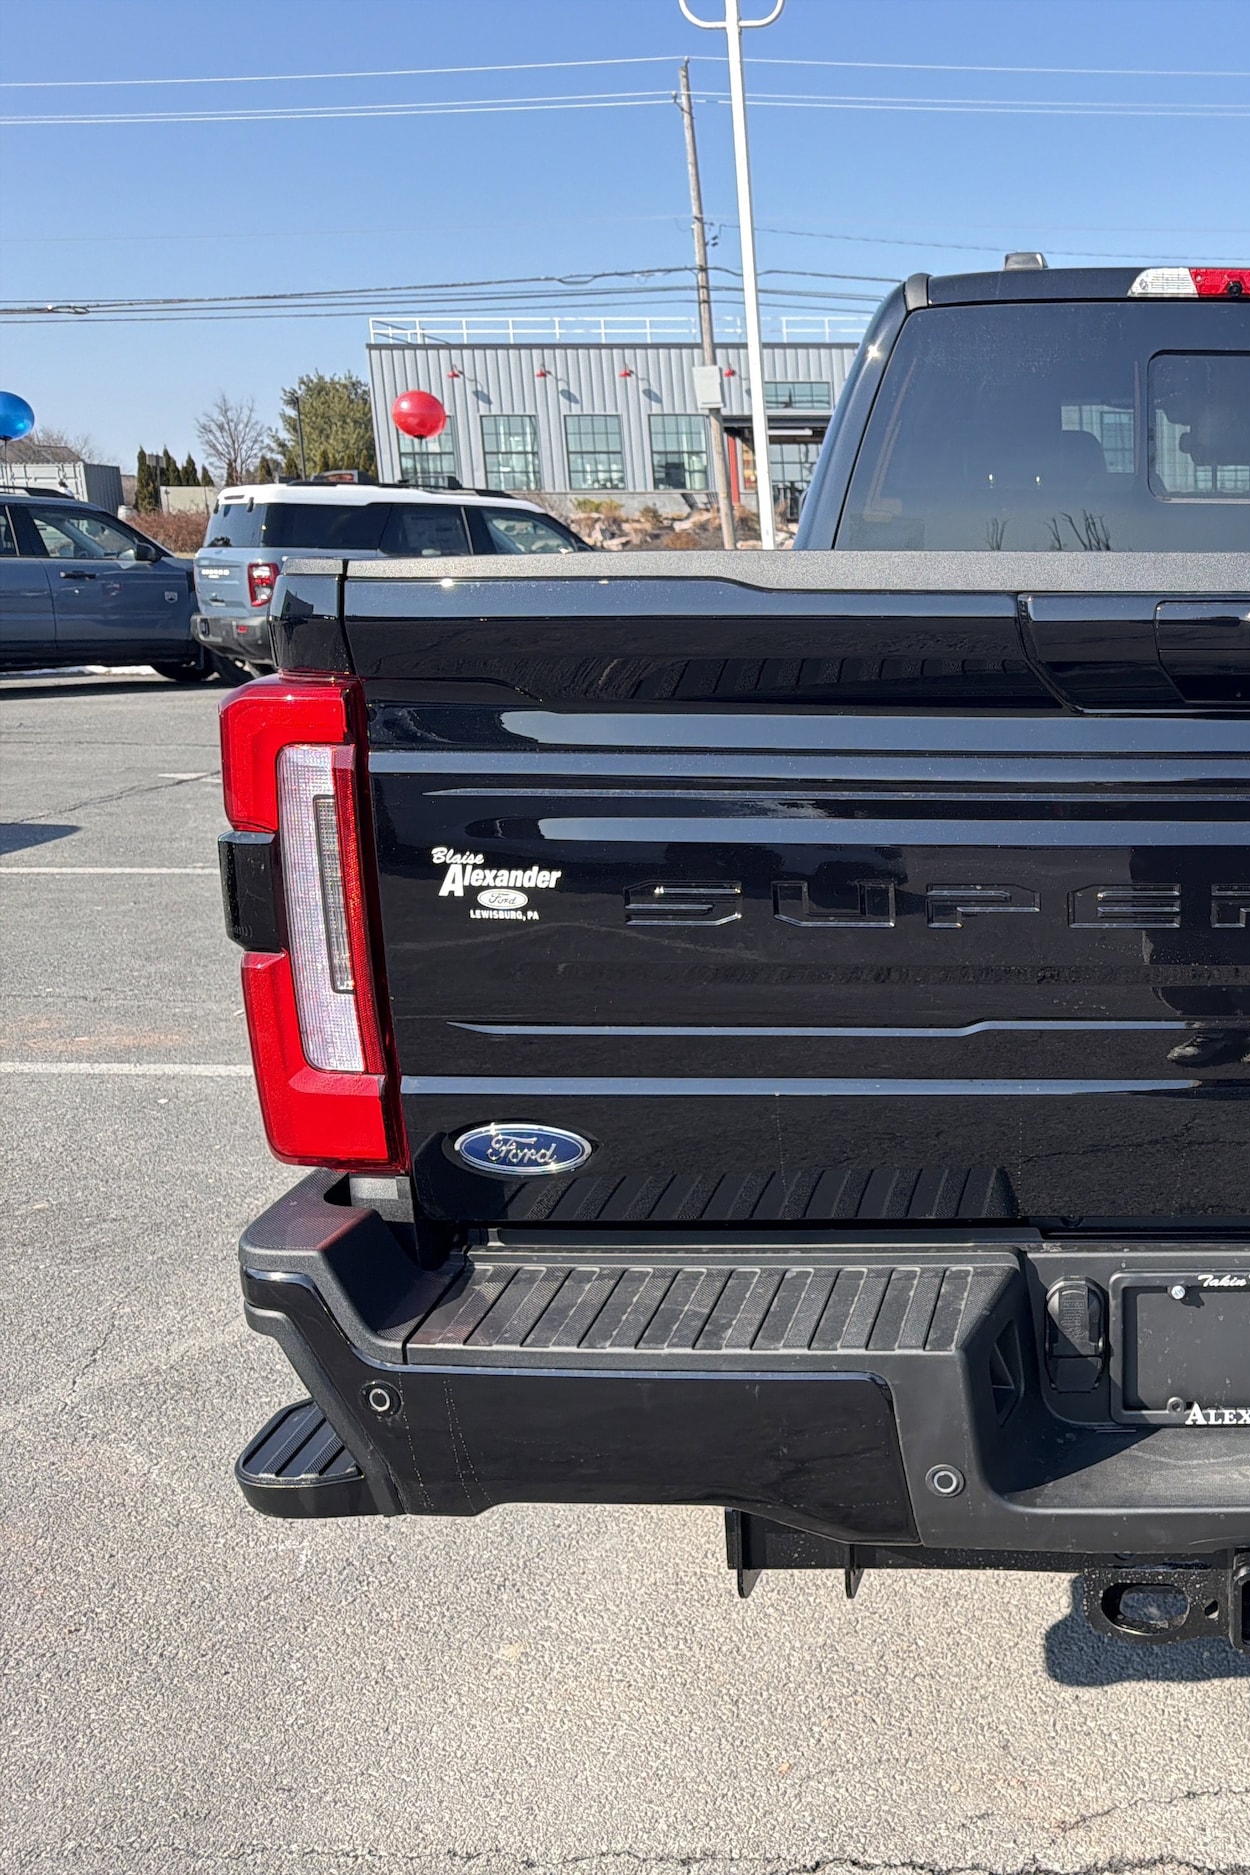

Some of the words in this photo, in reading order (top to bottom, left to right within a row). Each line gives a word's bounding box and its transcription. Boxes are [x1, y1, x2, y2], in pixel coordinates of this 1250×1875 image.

[431, 847, 484, 865] Blaise
[438, 864, 562, 896] Alexander
[488, 893, 517, 904] Ford
[469, 909, 526, 922] LEWISBURG,
[527, 910, 539, 920] PA
[486, 1135, 557, 1164] Ford
